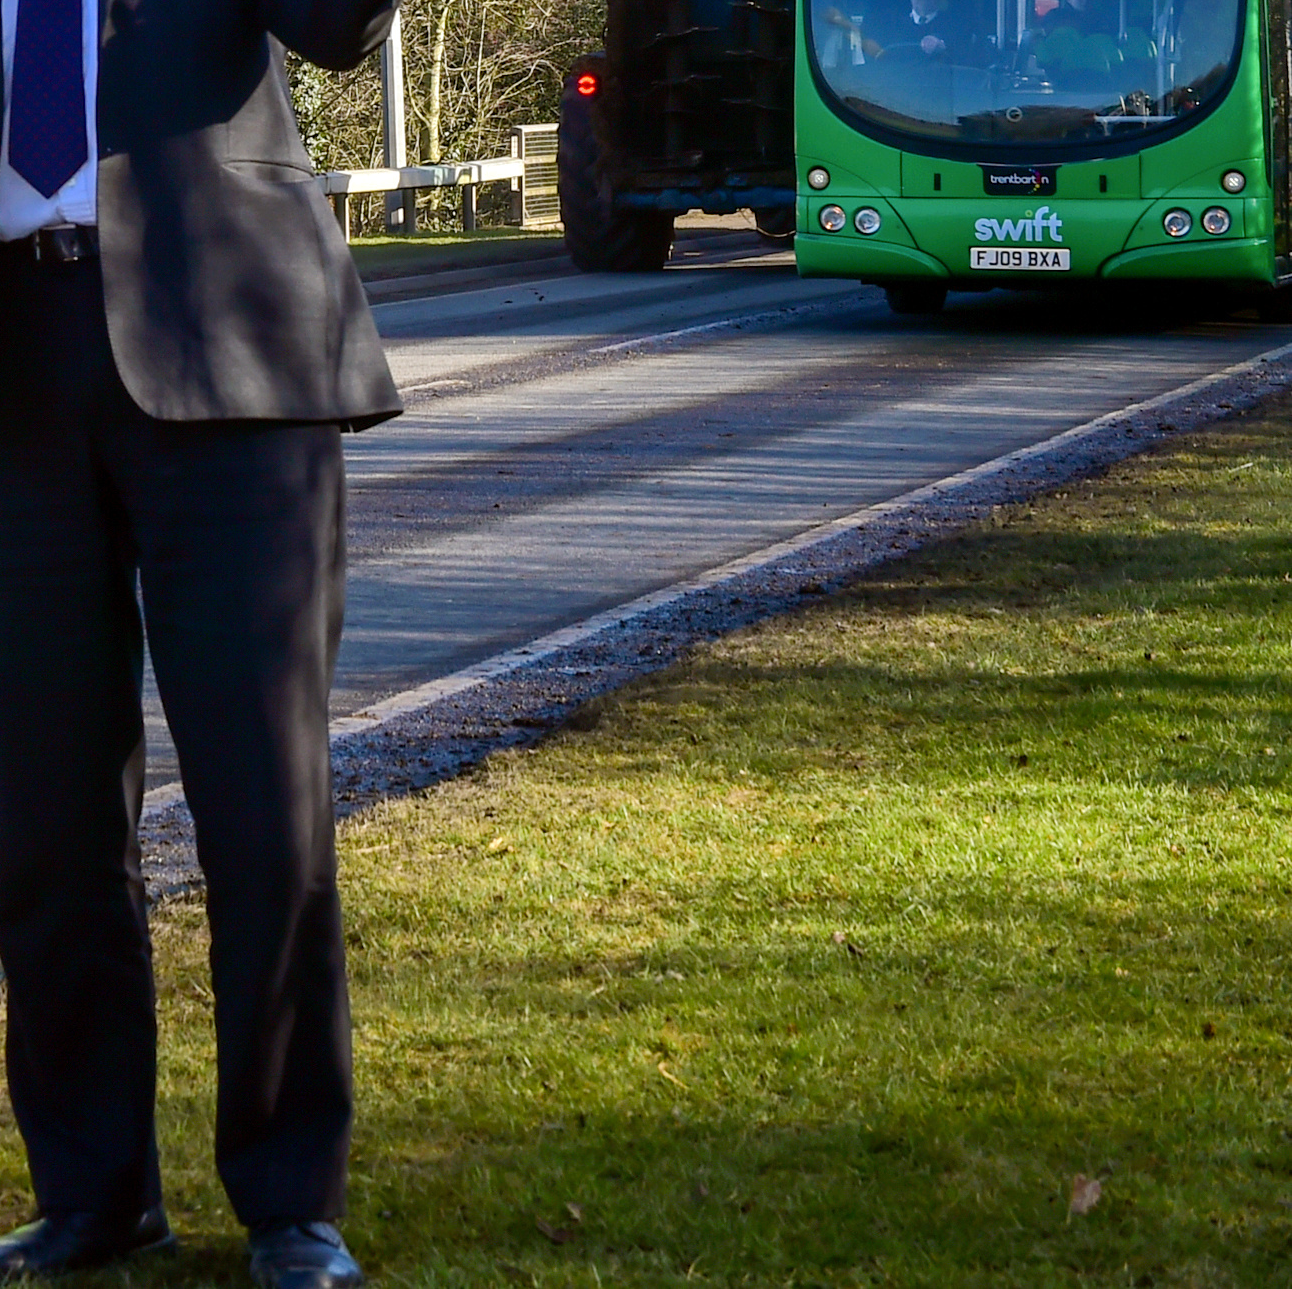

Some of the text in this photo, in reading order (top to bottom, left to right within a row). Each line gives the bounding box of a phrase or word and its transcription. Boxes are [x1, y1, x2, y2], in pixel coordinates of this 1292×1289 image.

[974, 206, 1063, 242] swift
[977, 251, 1061, 267] FJ09 BXA
